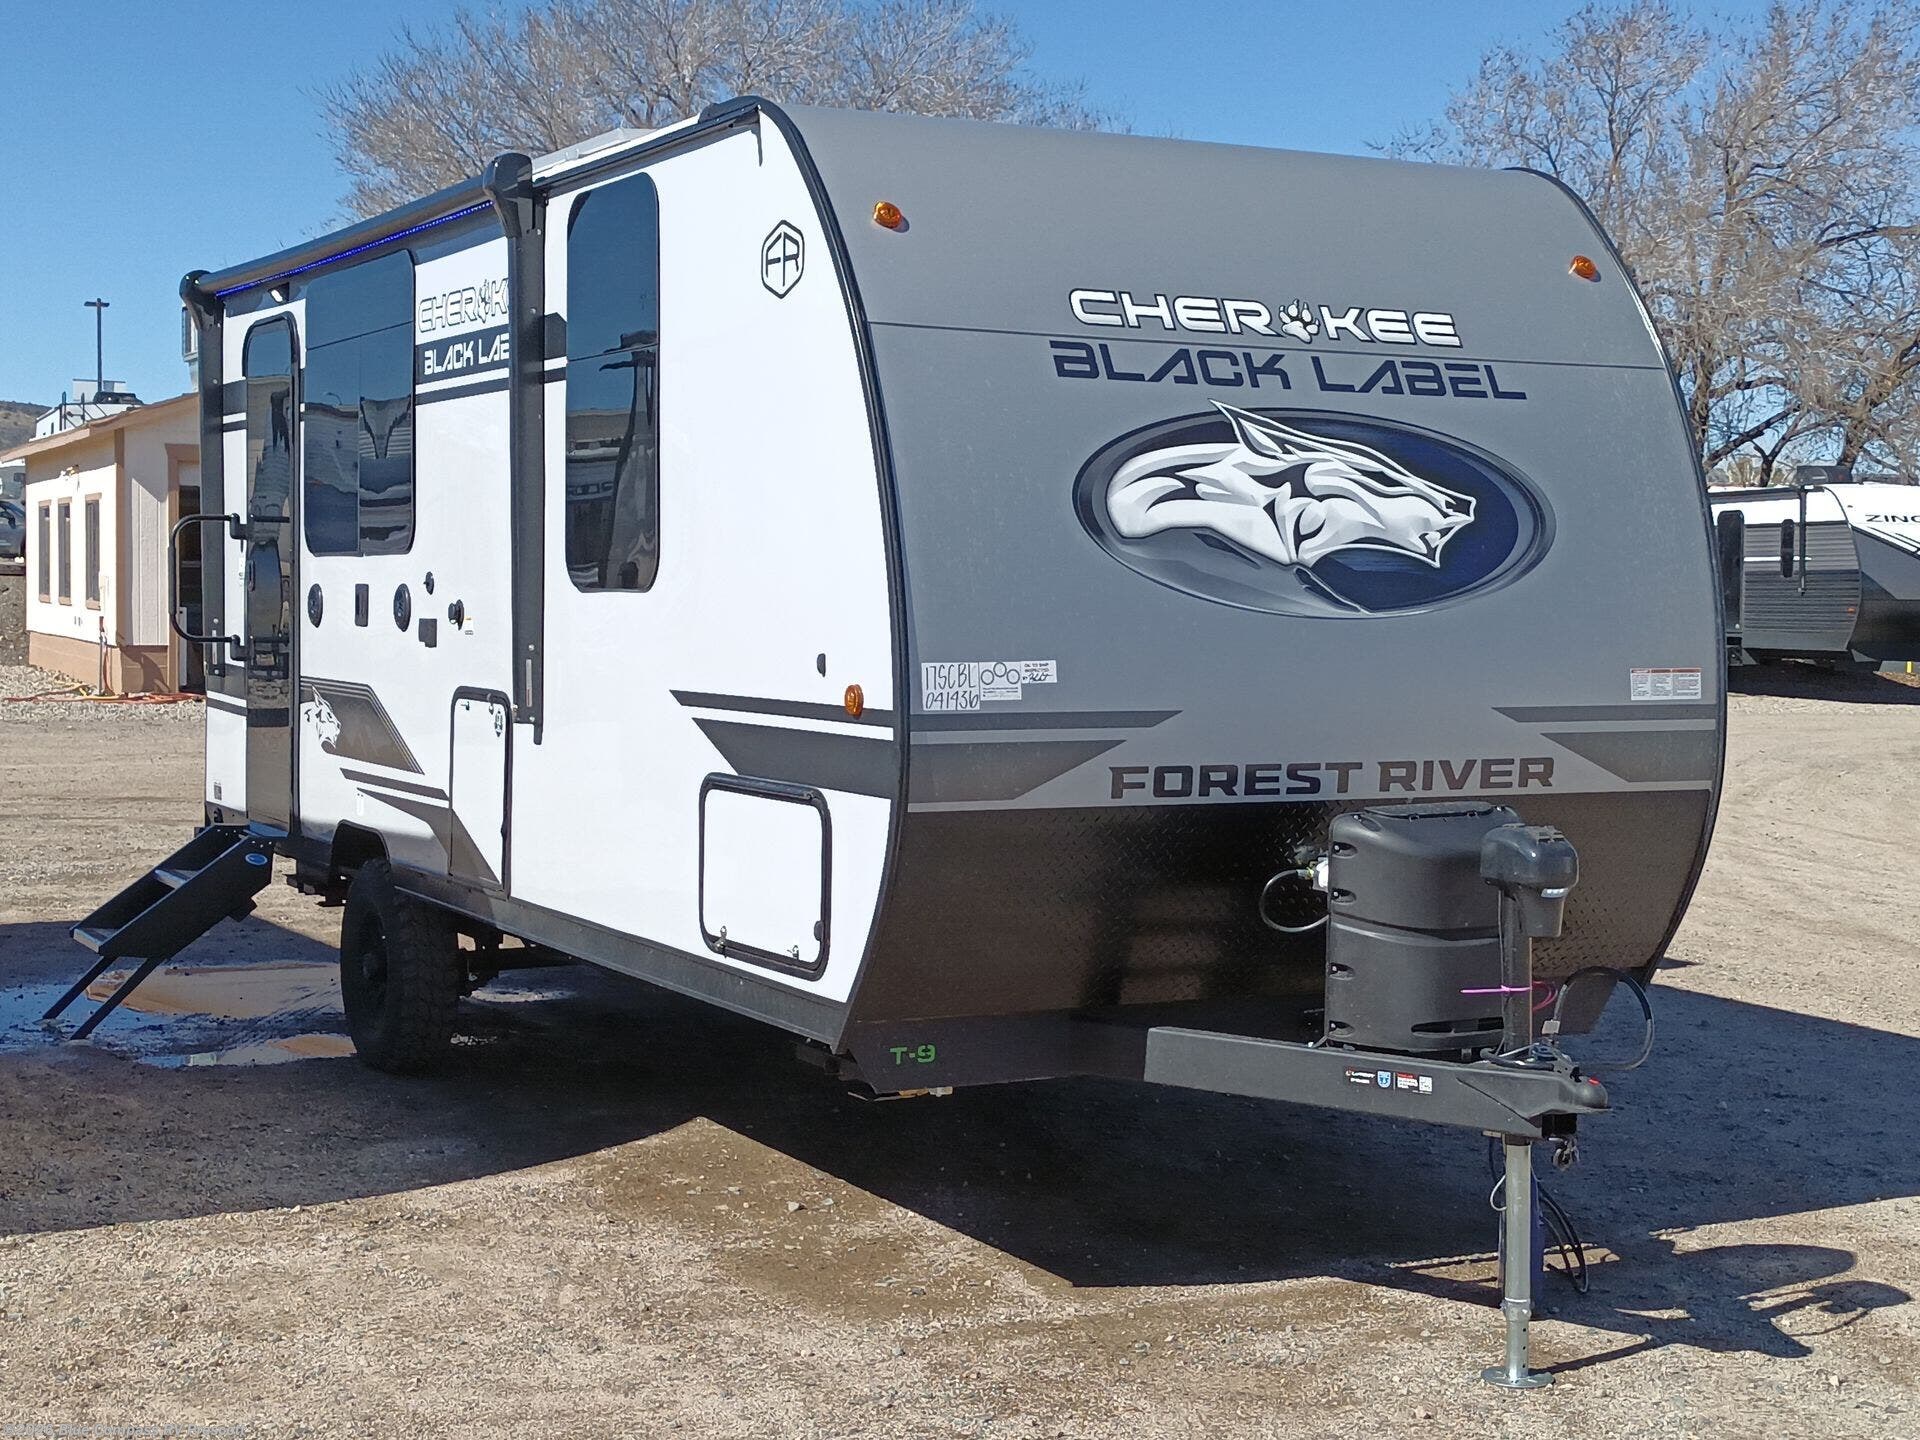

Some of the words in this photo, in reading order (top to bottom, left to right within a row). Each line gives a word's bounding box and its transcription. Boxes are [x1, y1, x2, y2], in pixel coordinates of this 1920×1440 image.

[424, 339, 474, 376] BLACK
[1048, 340, 1291, 390] BLACK
[1311, 355, 1527, 400] LABEL
[1109, 762, 1363, 799] FOREST
[1378, 757, 1555, 792] RIVER
[889, 1044, 936, 1065] T-9
